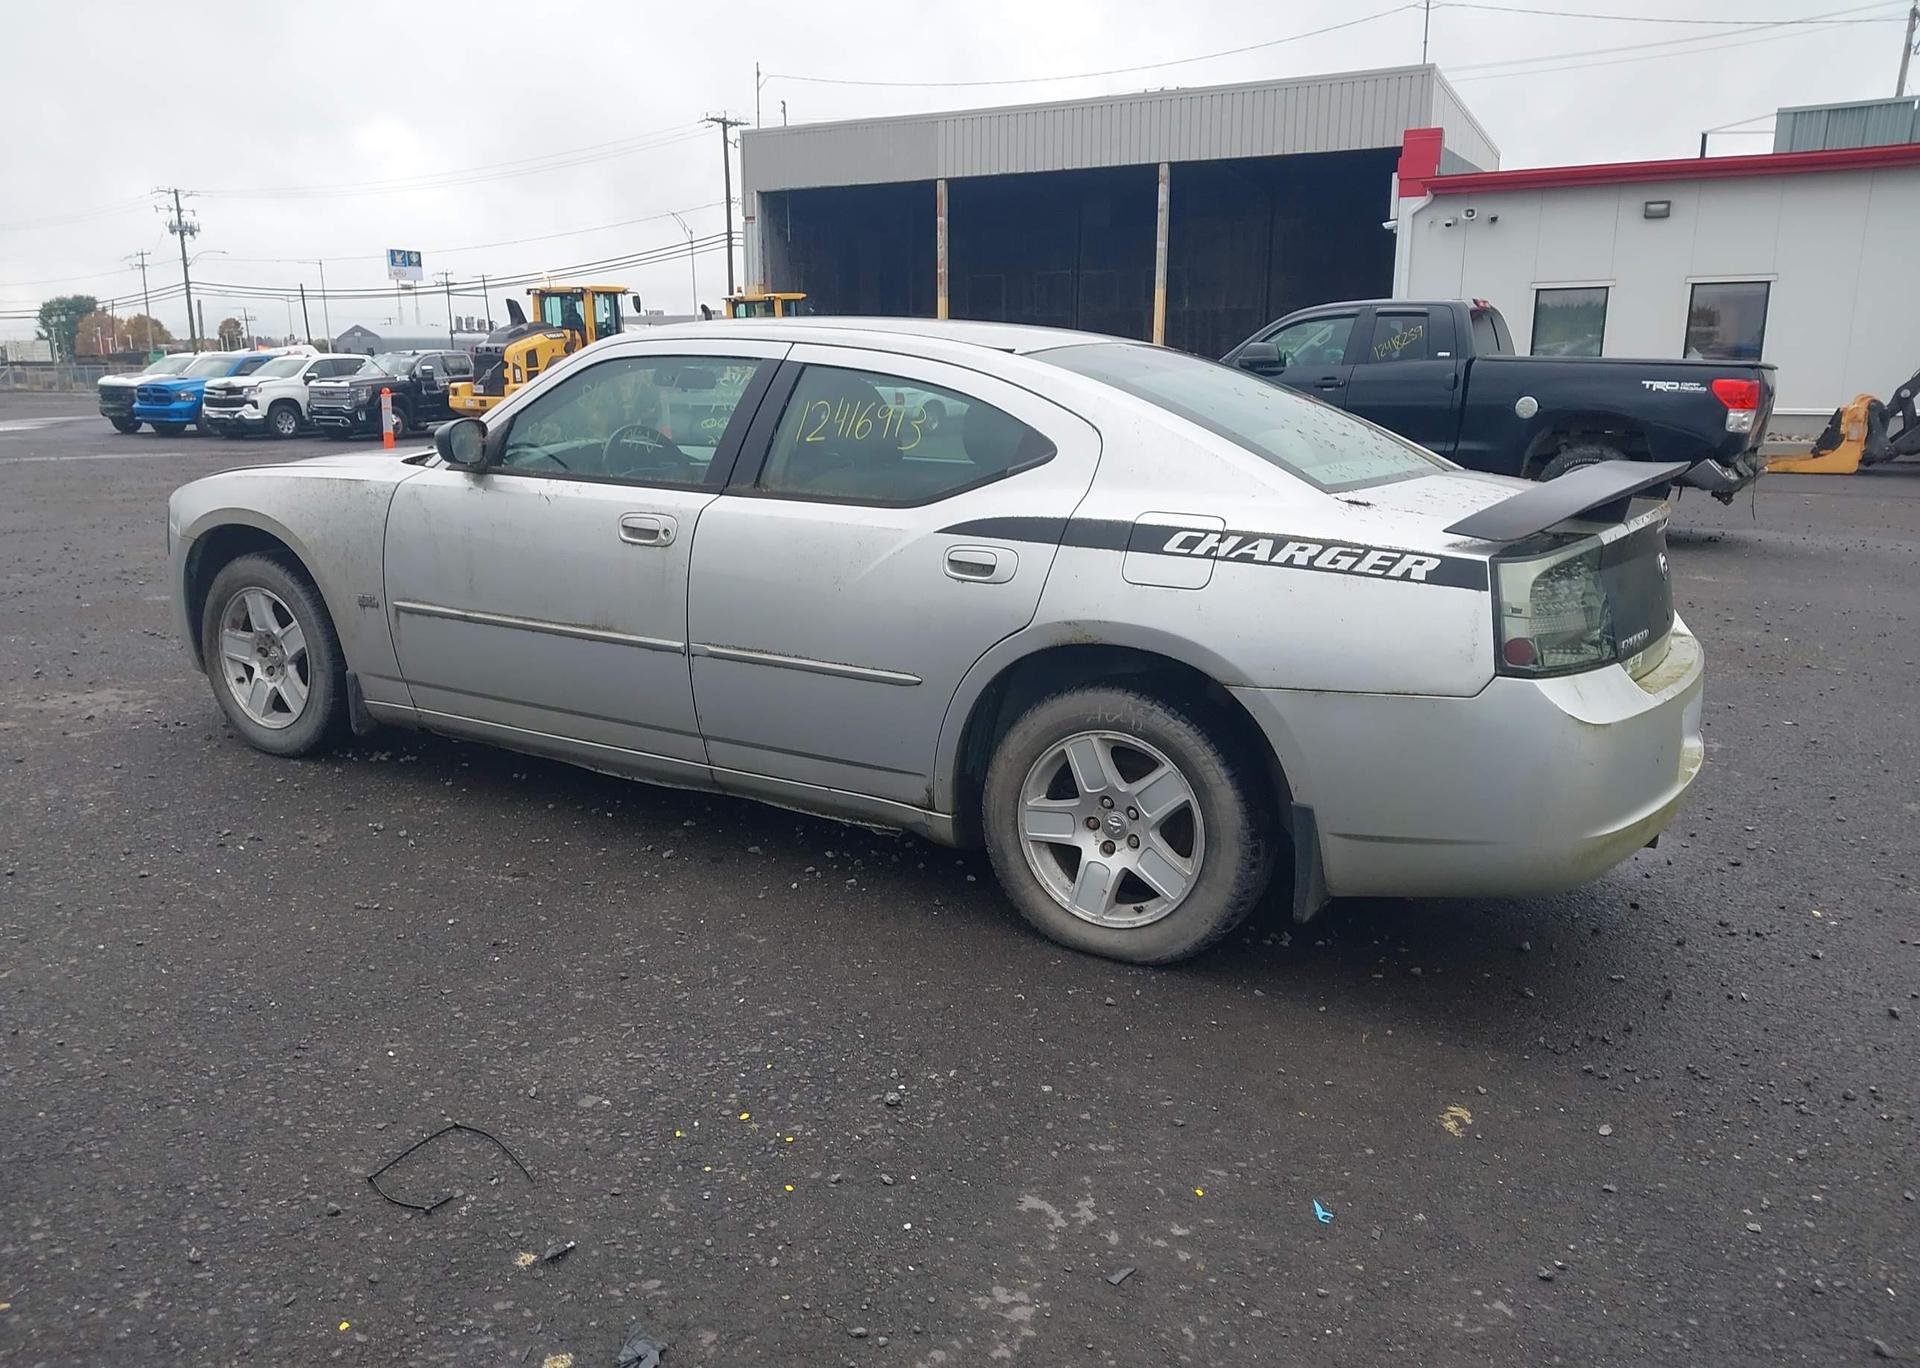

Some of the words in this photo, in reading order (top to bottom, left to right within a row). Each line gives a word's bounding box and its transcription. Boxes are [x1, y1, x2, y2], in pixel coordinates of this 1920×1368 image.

[1641, 380, 1680, 392] TRD
[796, 397, 927, 450] 12416913
[1162, 530, 1441, 582] CHARGER
